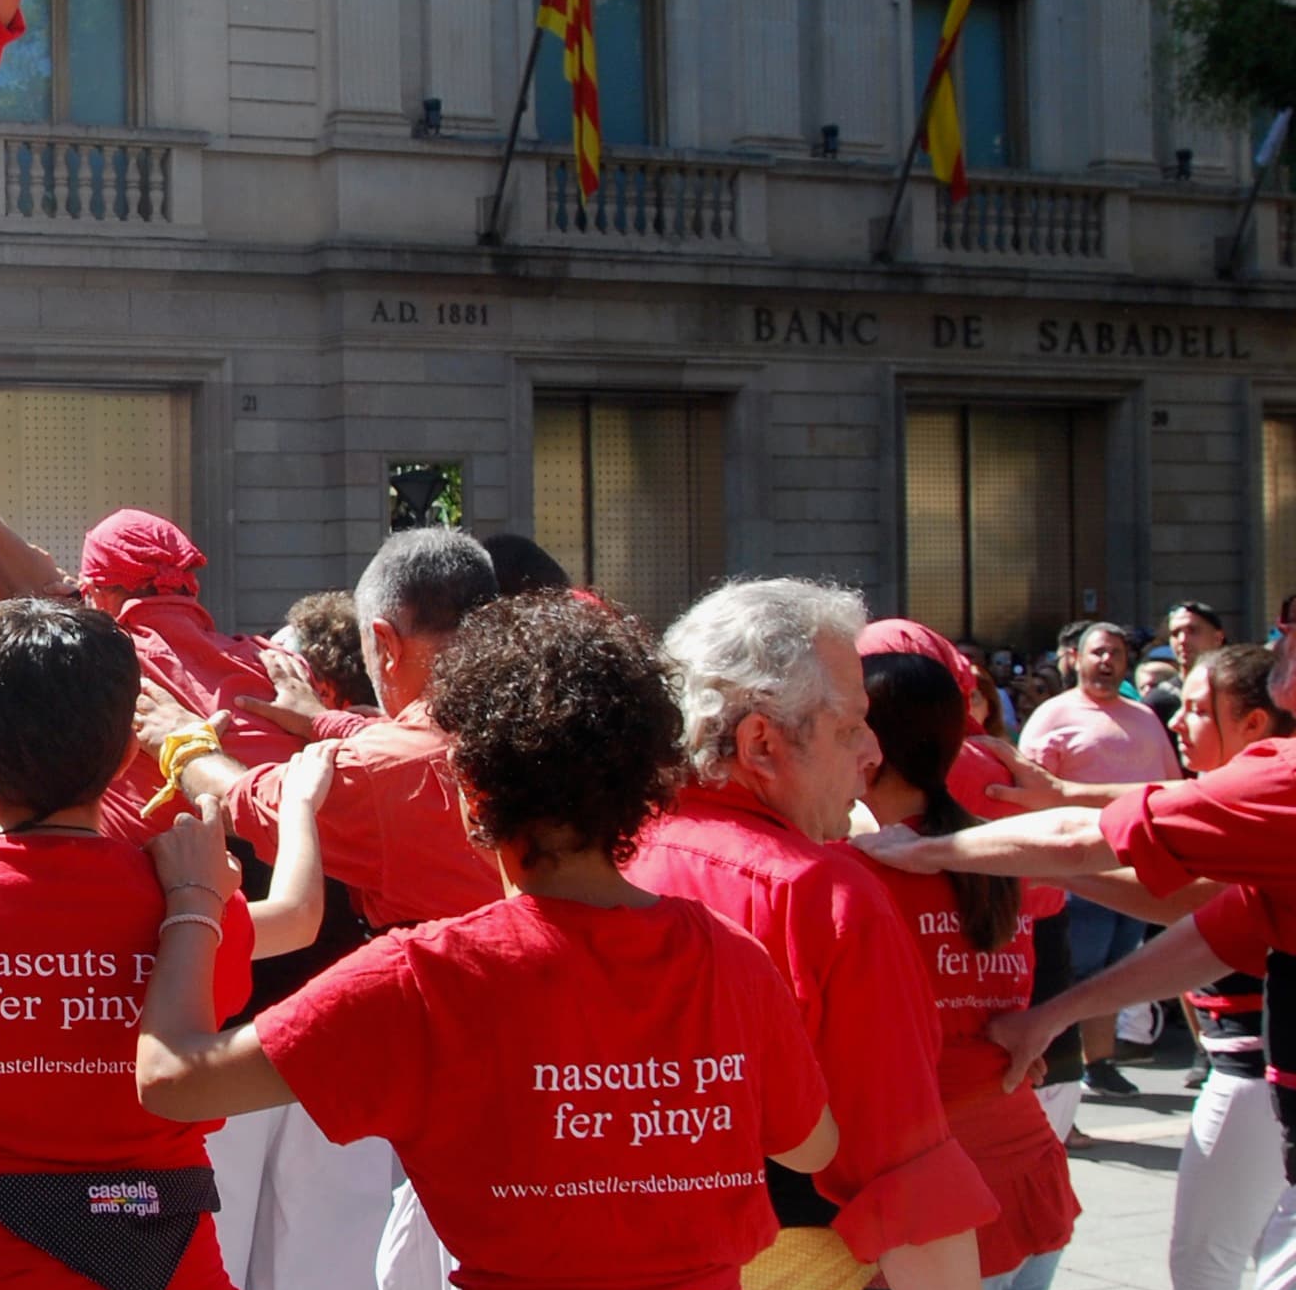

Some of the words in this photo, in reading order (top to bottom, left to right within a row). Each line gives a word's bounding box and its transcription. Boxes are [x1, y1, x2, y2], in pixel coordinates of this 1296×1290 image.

[371, 299, 420, 324] A.D.
[437, 303, 488, 326] 1881
[754, 307, 878, 346] BANC
[933, 314, 985, 350] DE
[1038, 320, 1251, 359] SABADELL
[937, 943, 969, 976] fer
[60, 986, 144, 1030] piny
[532, 1057, 681, 1091] nascuts
[694, 1053, 745, 1094] per
[553, 1102, 613, 1139] fer
[629, 1099, 732, 1146] pinya
[88, 1181, 158, 1199] castells
[490, 1168, 765, 1199] www.castellersdebarcelona.c
[90, 1201, 121, 1213] amb
[124, 1200, 160, 1217] orgull
